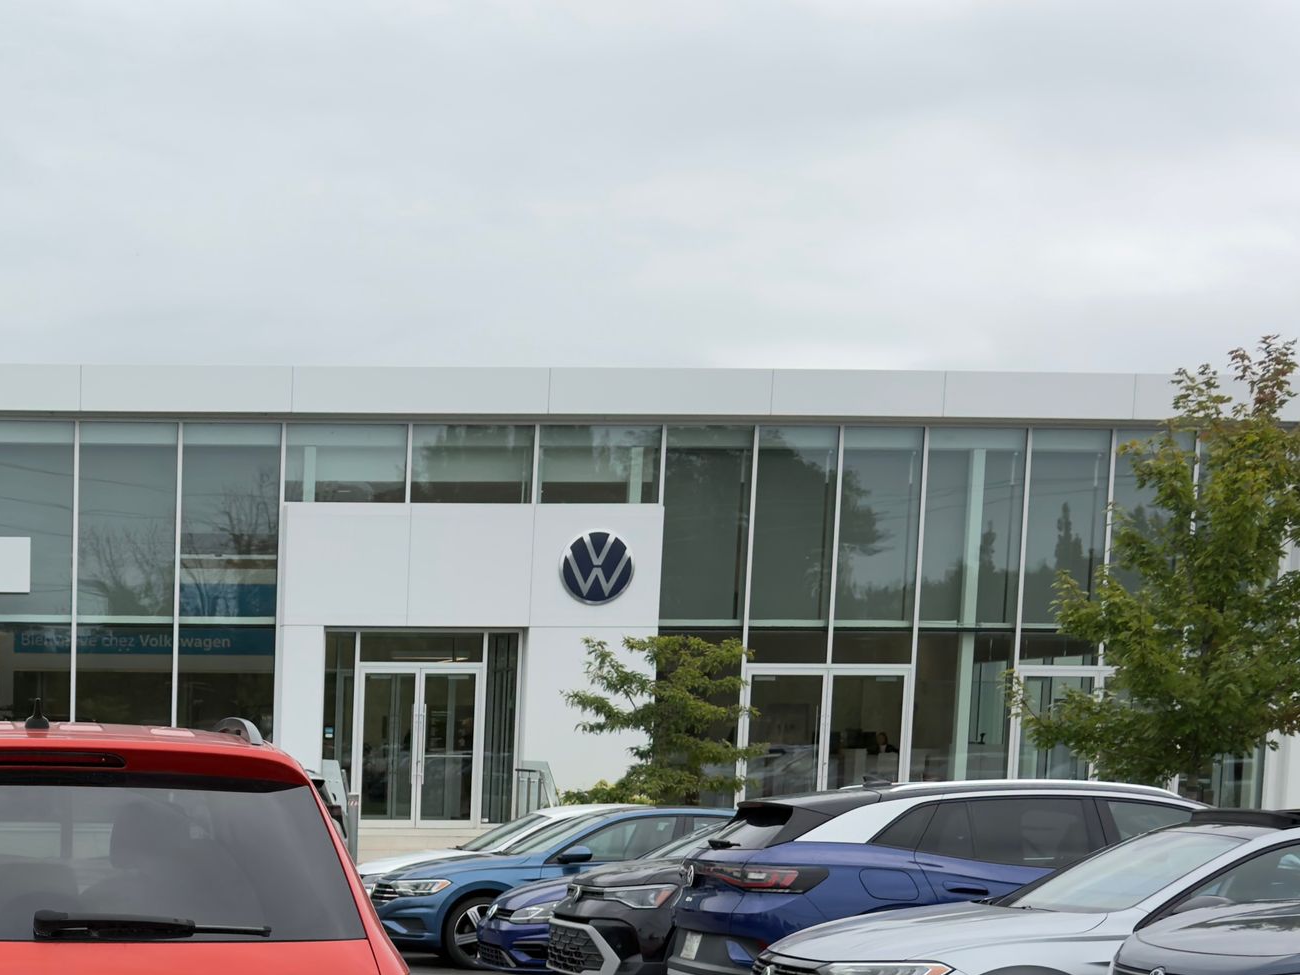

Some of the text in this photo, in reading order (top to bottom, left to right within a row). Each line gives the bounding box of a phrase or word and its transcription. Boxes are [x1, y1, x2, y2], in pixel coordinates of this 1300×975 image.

[561, 530, 633, 602] VW
[21, 632, 231, 652] Bienveue chez Volkwagen
